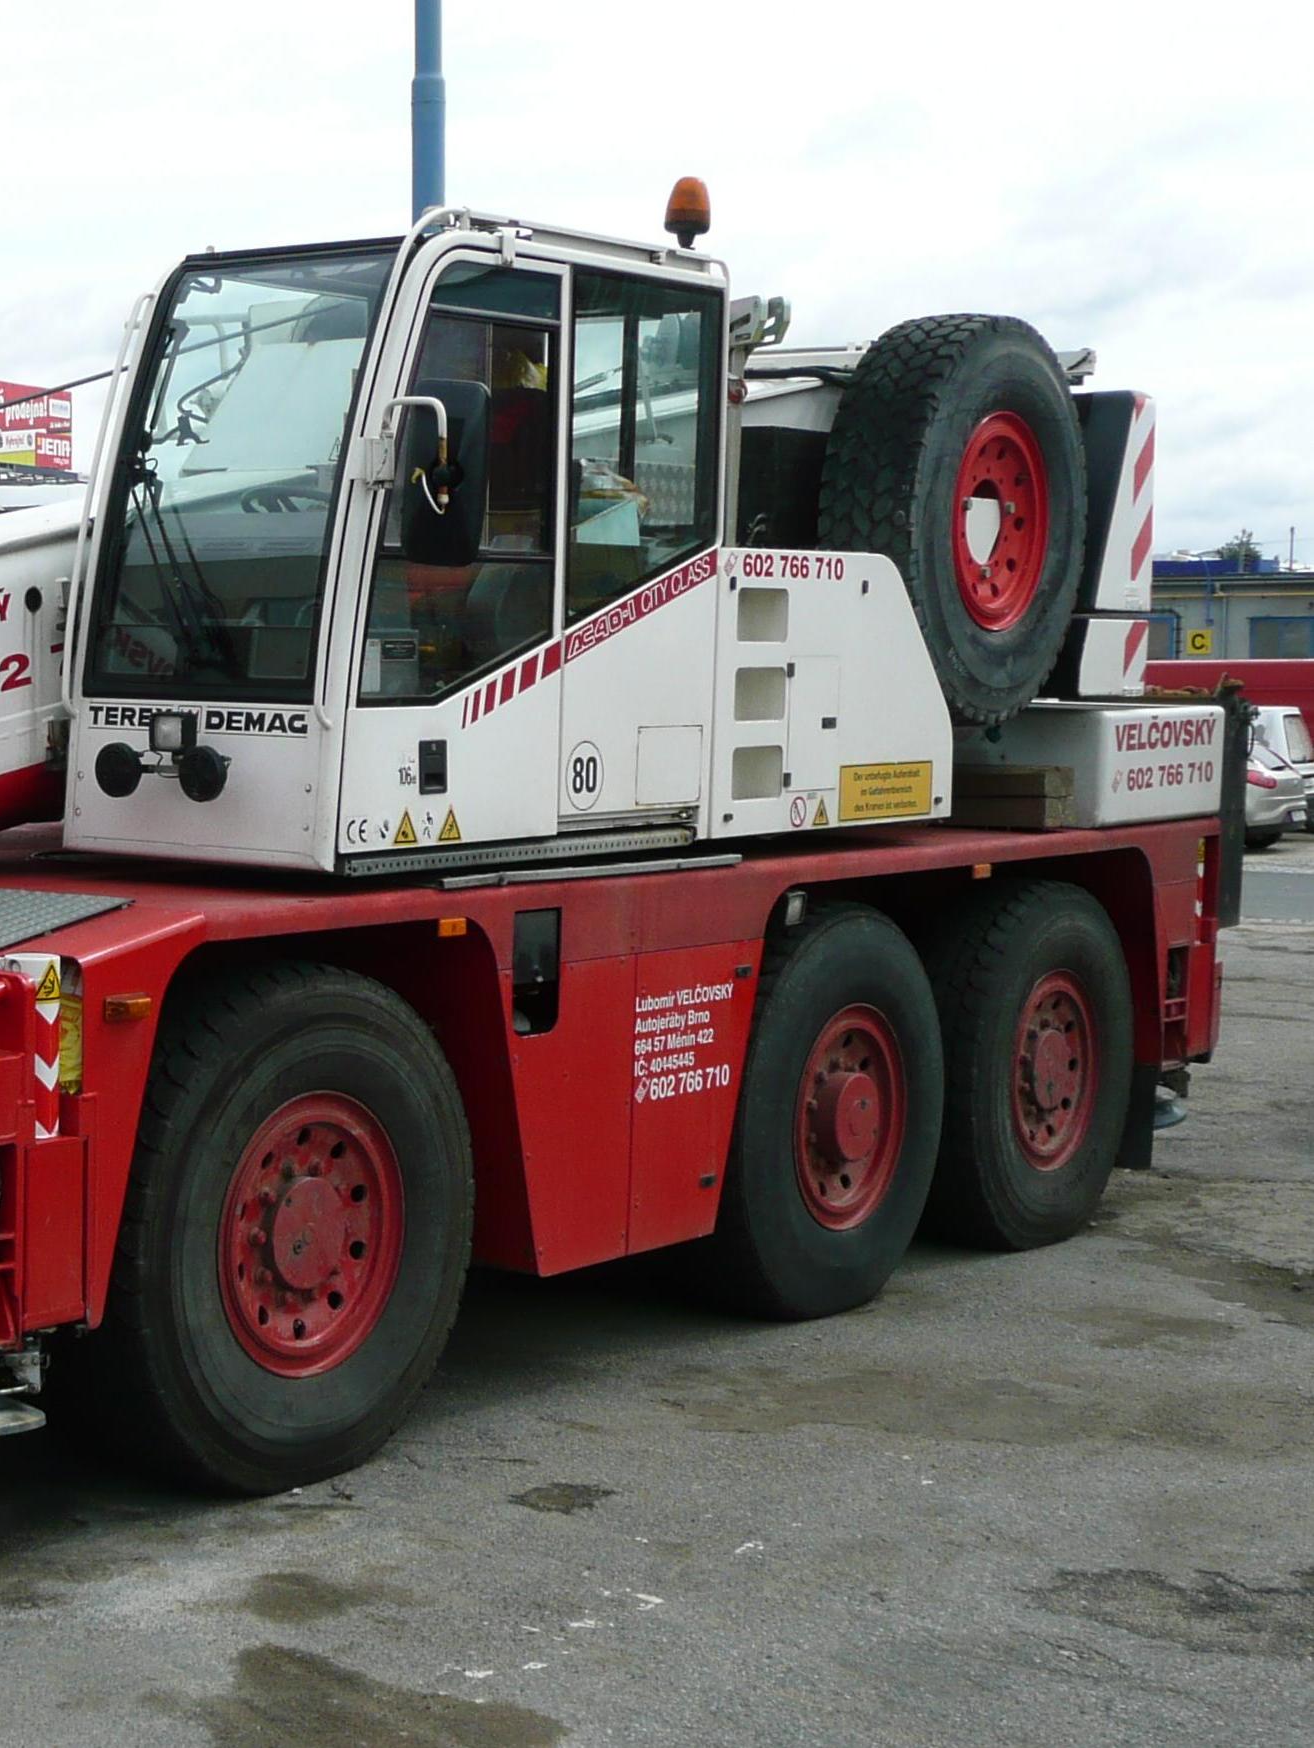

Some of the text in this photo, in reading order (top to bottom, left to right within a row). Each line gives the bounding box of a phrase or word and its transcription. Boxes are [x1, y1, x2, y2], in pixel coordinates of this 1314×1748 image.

[5, 395, 47, 427] prodejna!
[743, 553, 844, 580] 602 766 710
[641, 580, 668, 612] CITY
[671, 556, 711, 595] CLASS
[1191, 633, 1206, 650] C
[89, 705, 309, 734] TERE DEMAG
[1115, 712, 1216, 752] VELČOVSKÝ
[572, 756, 597, 794] 80
[1127, 761, 1214, 791] 602 766 710
[636, 979, 734, 1013] Lubomír VELČOVSKÝ
[634, 1009, 710, 1034] Autojeřáby Brno
[634, 1038, 652, 1056] 664
[653, 1036, 665, 1052] 57
[697, 1028, 714, 1044] 422
[634, 1051, 695, 1077] IČ: 40445445
[649, 1064, 730, 1101] 602 766 710
